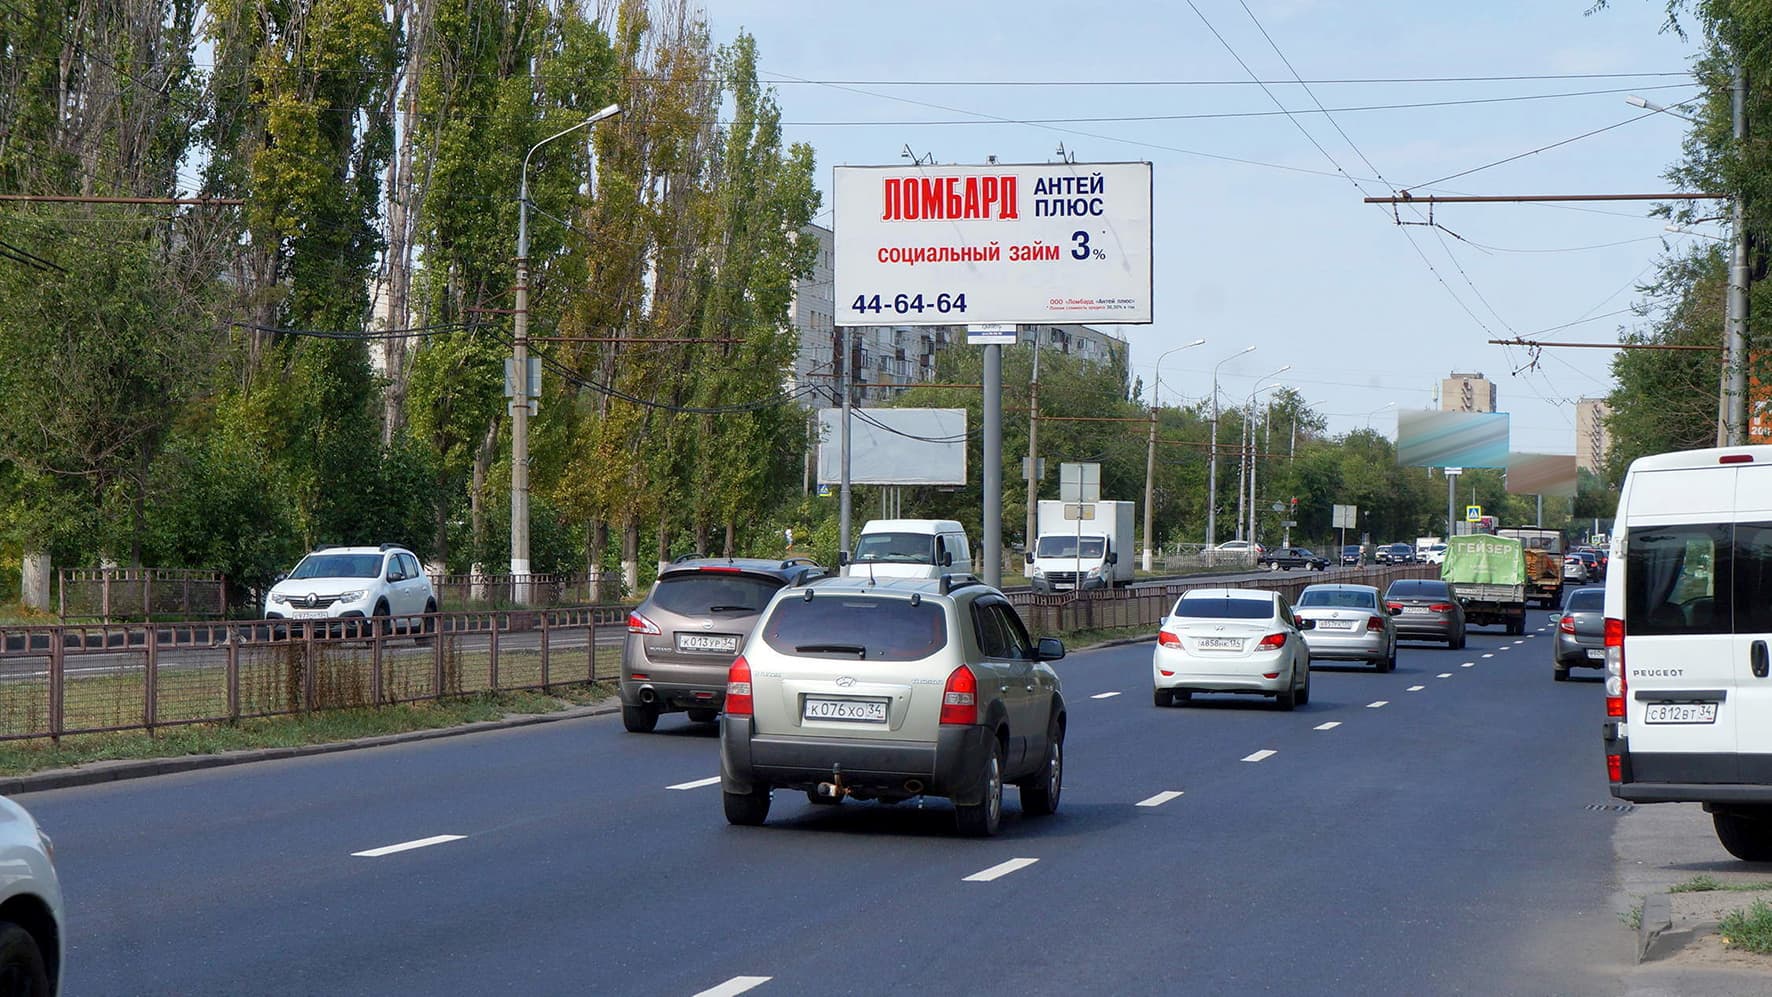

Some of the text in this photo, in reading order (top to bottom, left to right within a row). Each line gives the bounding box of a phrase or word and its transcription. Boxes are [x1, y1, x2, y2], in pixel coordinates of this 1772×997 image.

[1034, 173, 1104, 195] АНТЕЙ
[882, 176, 1018, 220] ЛОМБАРД
[1035, 198, 1103, 217] ПЛЮС
[877, 242, 1000, 266] социальный
[1009, 241, 1060, 262] займ
[852, 293, 968, 314] 44-64-64
[1457, 541, 1512, 554] ГЕЙЗЕР
[1633, 669, 1684, 677] PEUGEOT
